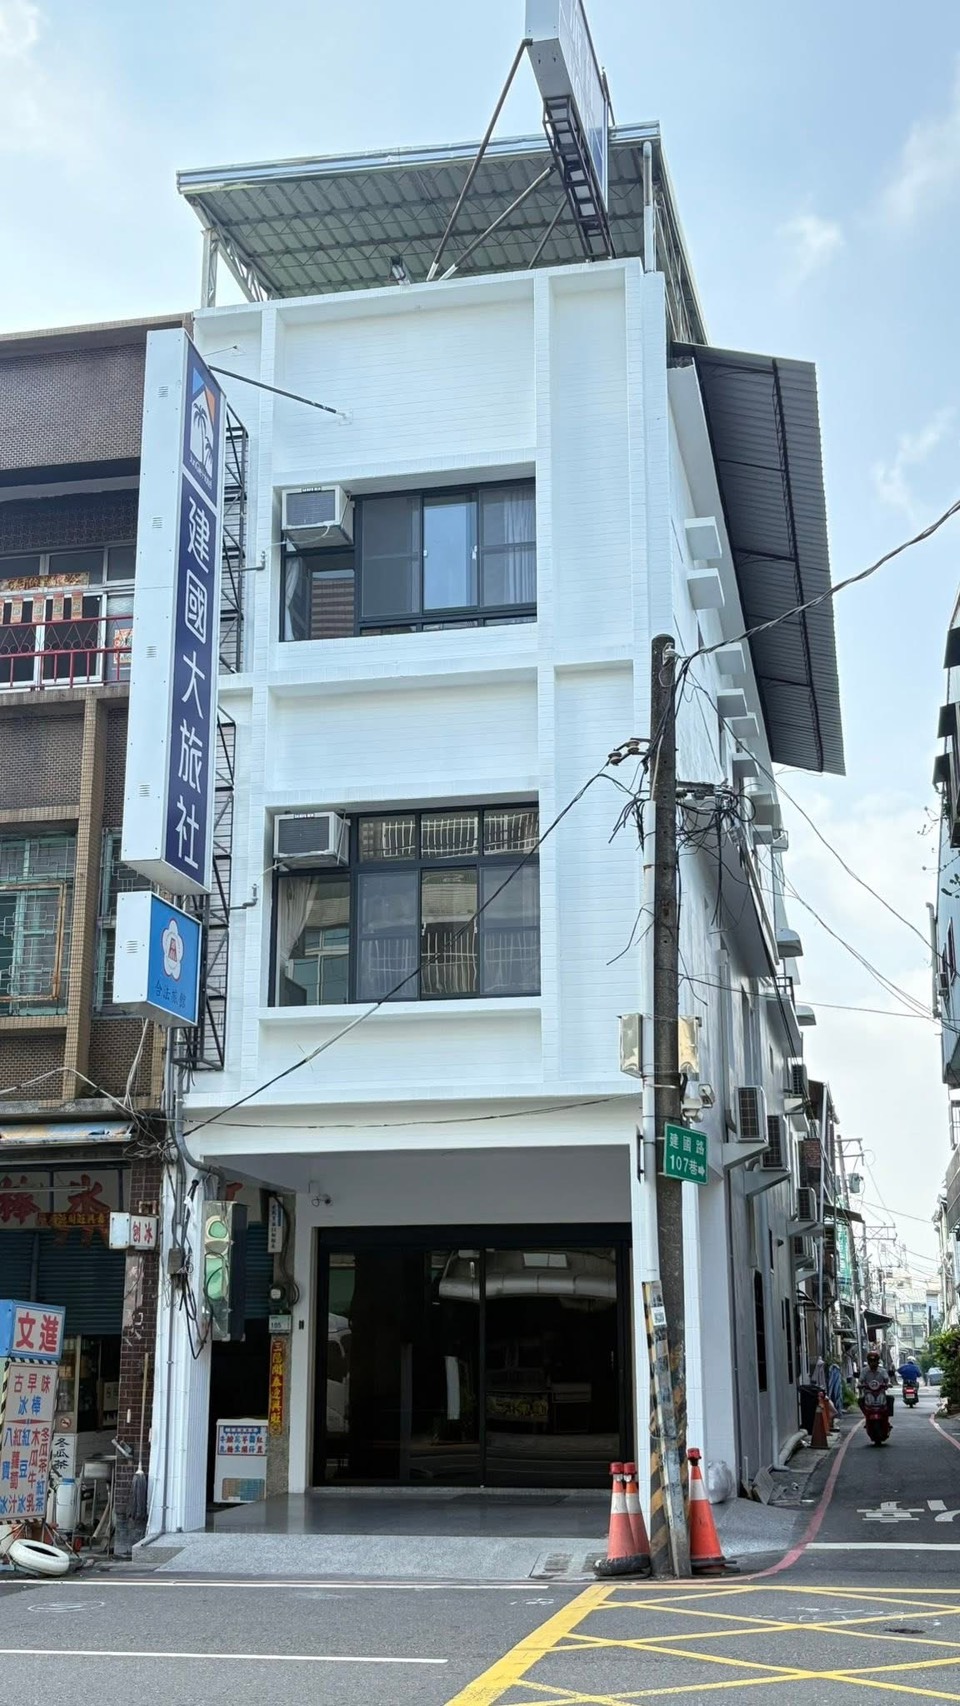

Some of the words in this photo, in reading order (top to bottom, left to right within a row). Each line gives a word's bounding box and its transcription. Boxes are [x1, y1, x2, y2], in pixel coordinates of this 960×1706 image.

[175, 496, 210, 870] 建國大旅社
[670, 1132, 705, 1156] 建國路
[670, 1154, 698, 1176] 107巷
[132, 1221, 154, 1244] 刨冰
[16, 1312, 60, 1352] 文進
[14, 1373, 51, 1394] 古早味
[18, 1395, 42, 1416] 冰棒
[54, 1437, 71, 1471] 冬瓜茶
[17, 1428, 31, 1513] 紅豆冰
[26, 1428, 41, 1512] 木瓜牛乳
